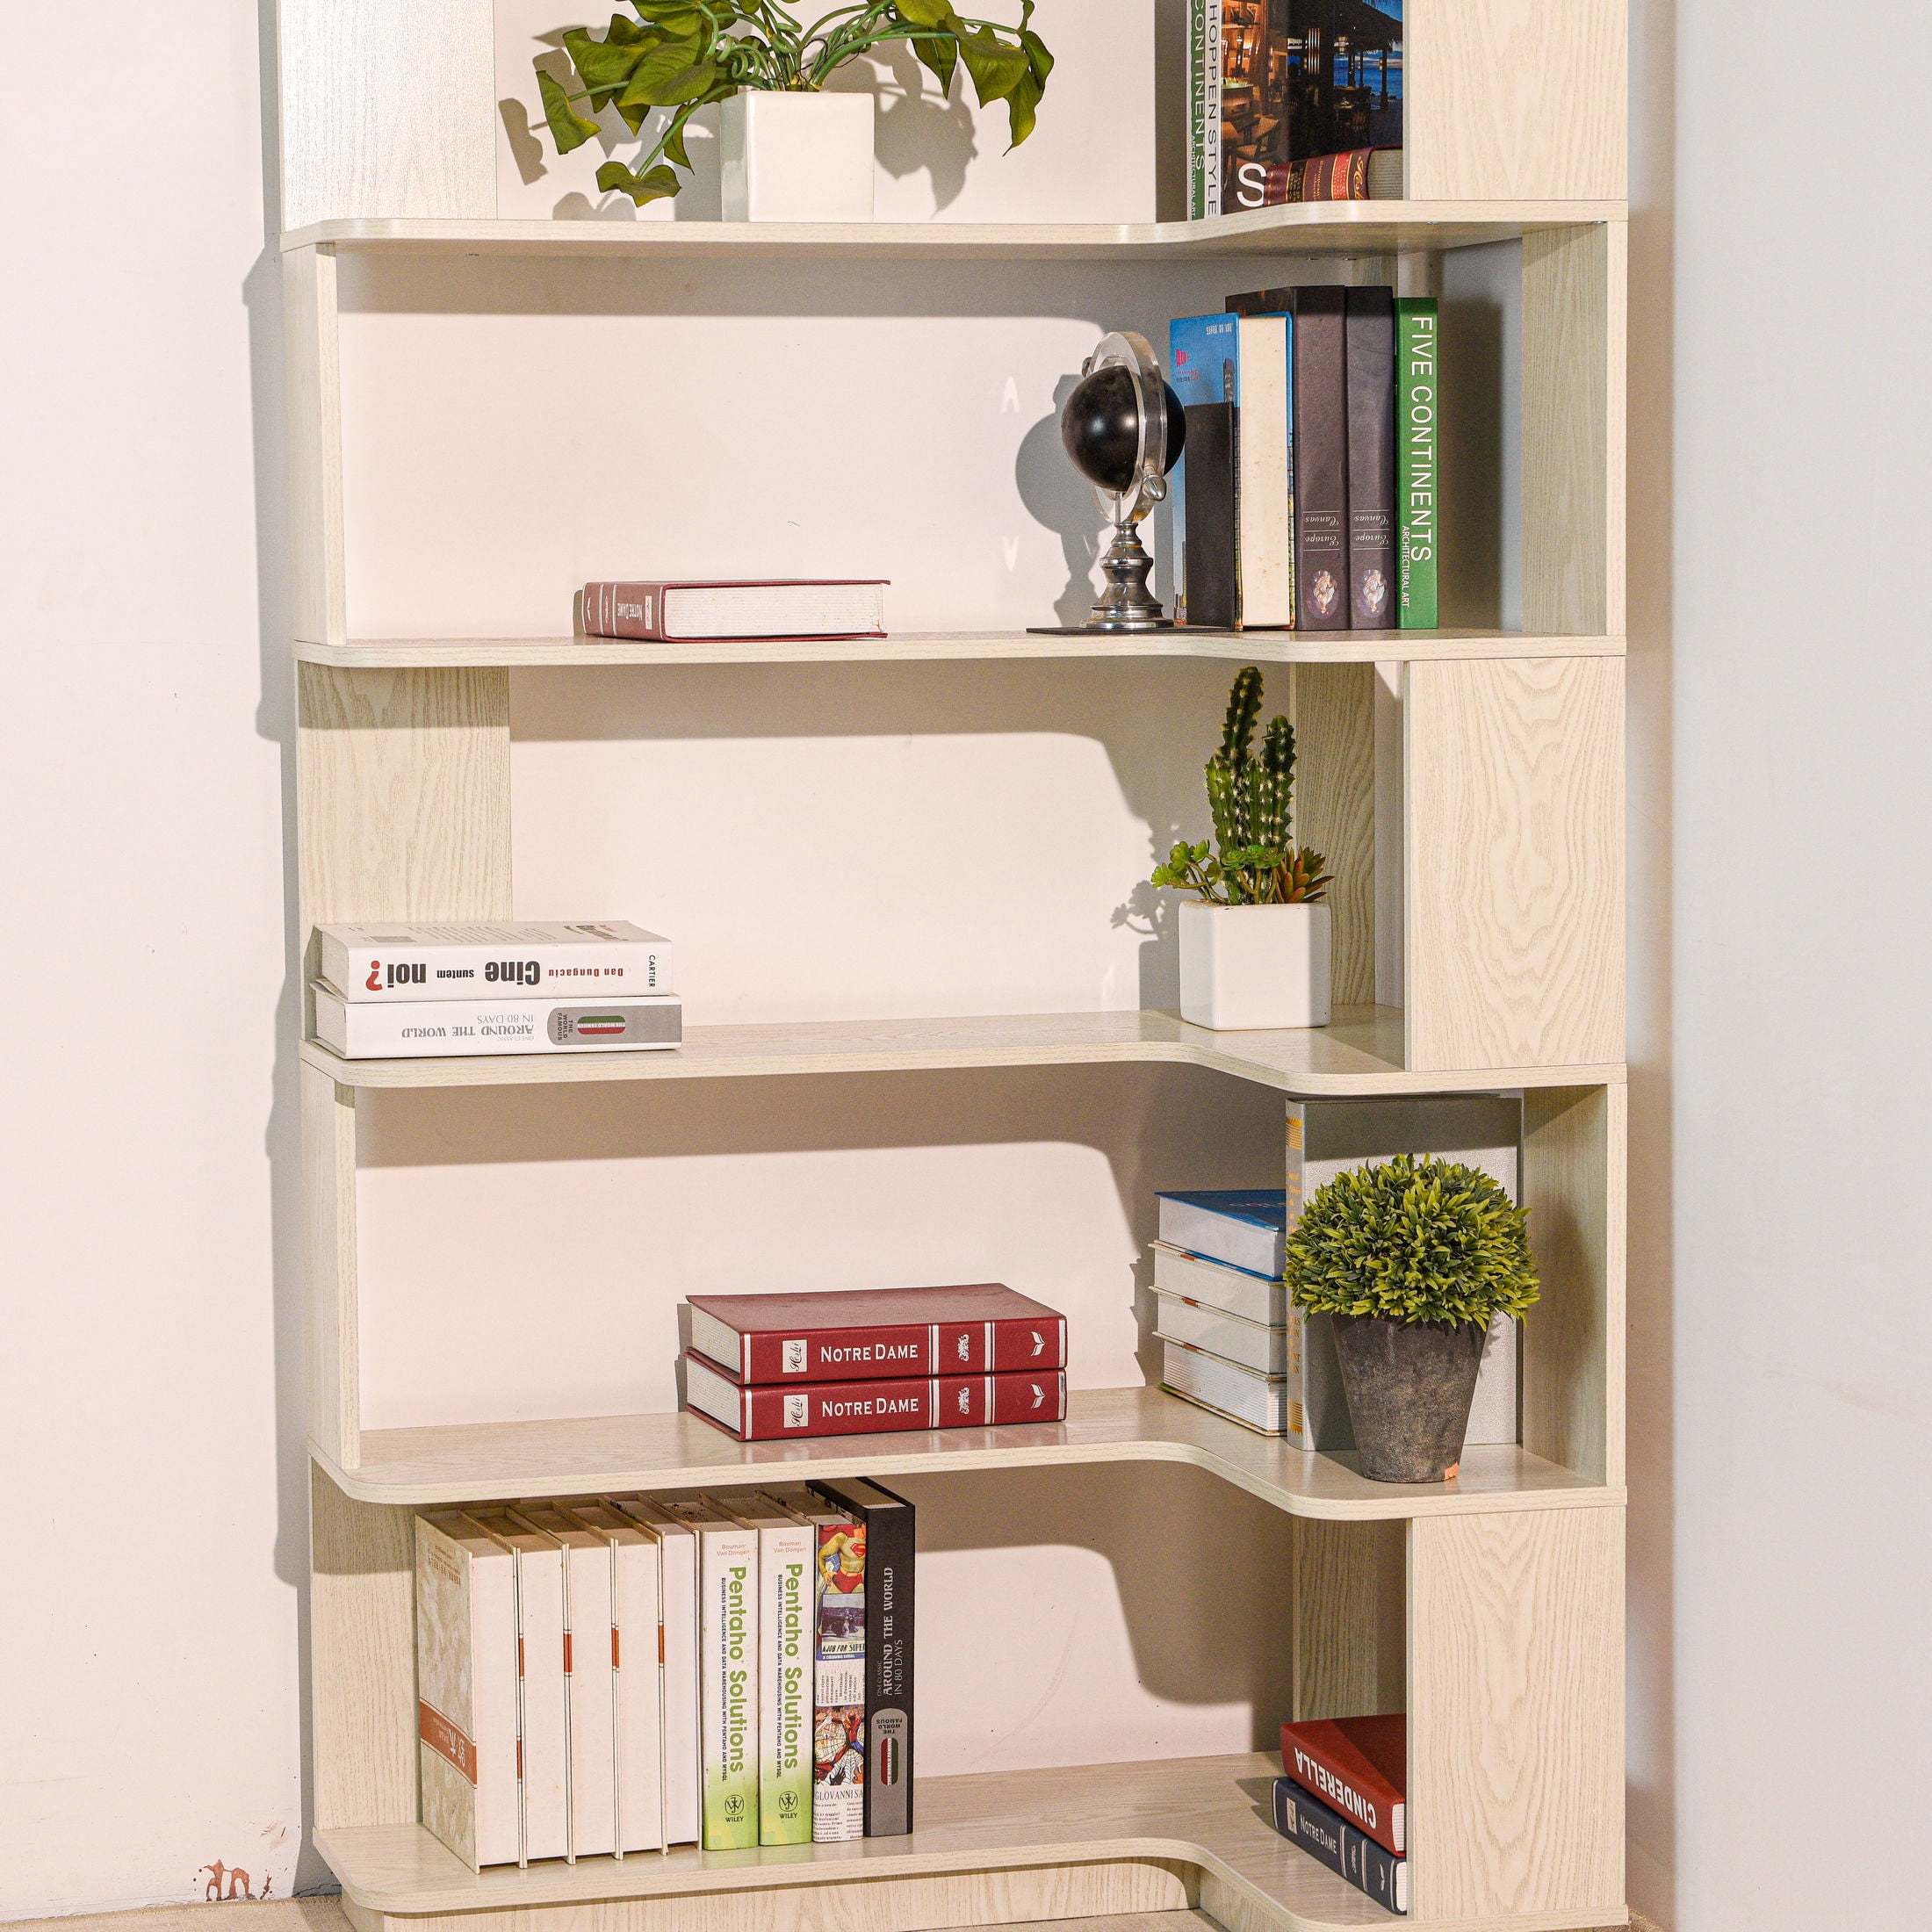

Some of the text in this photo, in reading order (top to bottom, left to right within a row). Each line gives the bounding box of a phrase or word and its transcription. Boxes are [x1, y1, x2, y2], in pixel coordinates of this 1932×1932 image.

[1208, 5, 1217, 216] HOPPEN STYLE
[1410, 317, 1433, 561] FIVE CONTINENTS
[1305, 515, 1339, 526] Canvas
[1354, 514, 1389, 525] Canvas
[1305, 533, 1339, 546] Europe
[1355, 531, 1389, 544] Europe
[1402, 525, 1410, 608] ARCHITECTURAL ART
[436, 970, 474, 979] suntem
[485, 961, 541, 985] Cine
[548, 968, 600, 977] Dungaciu
[603, 968, 624, 977] Dan
[477, 1013, 534, 1025] IN 80 DAYS
[401, 1024, 534, 1038] AROUND THE WORLD
[820, 1343, 919, 1363] NOTRE DAME
[821, 1397, 919, 1417] NOTRE DAME
[883, 1567, 894, 1696] AROUND THE WORLD
[729, 1567, 747, 1772] Pentaho Solutions
[784, 1564, 803, 1769] Pentaho Solutions
[894, 1639, 903, 1695] IN 80 DAYS
[1294, 1747, 1377, 1829] CINDERELLA
[1300, 1813, 1320, 1842] NOTRE
[1320, 1827, 1337, 1855] DAME
